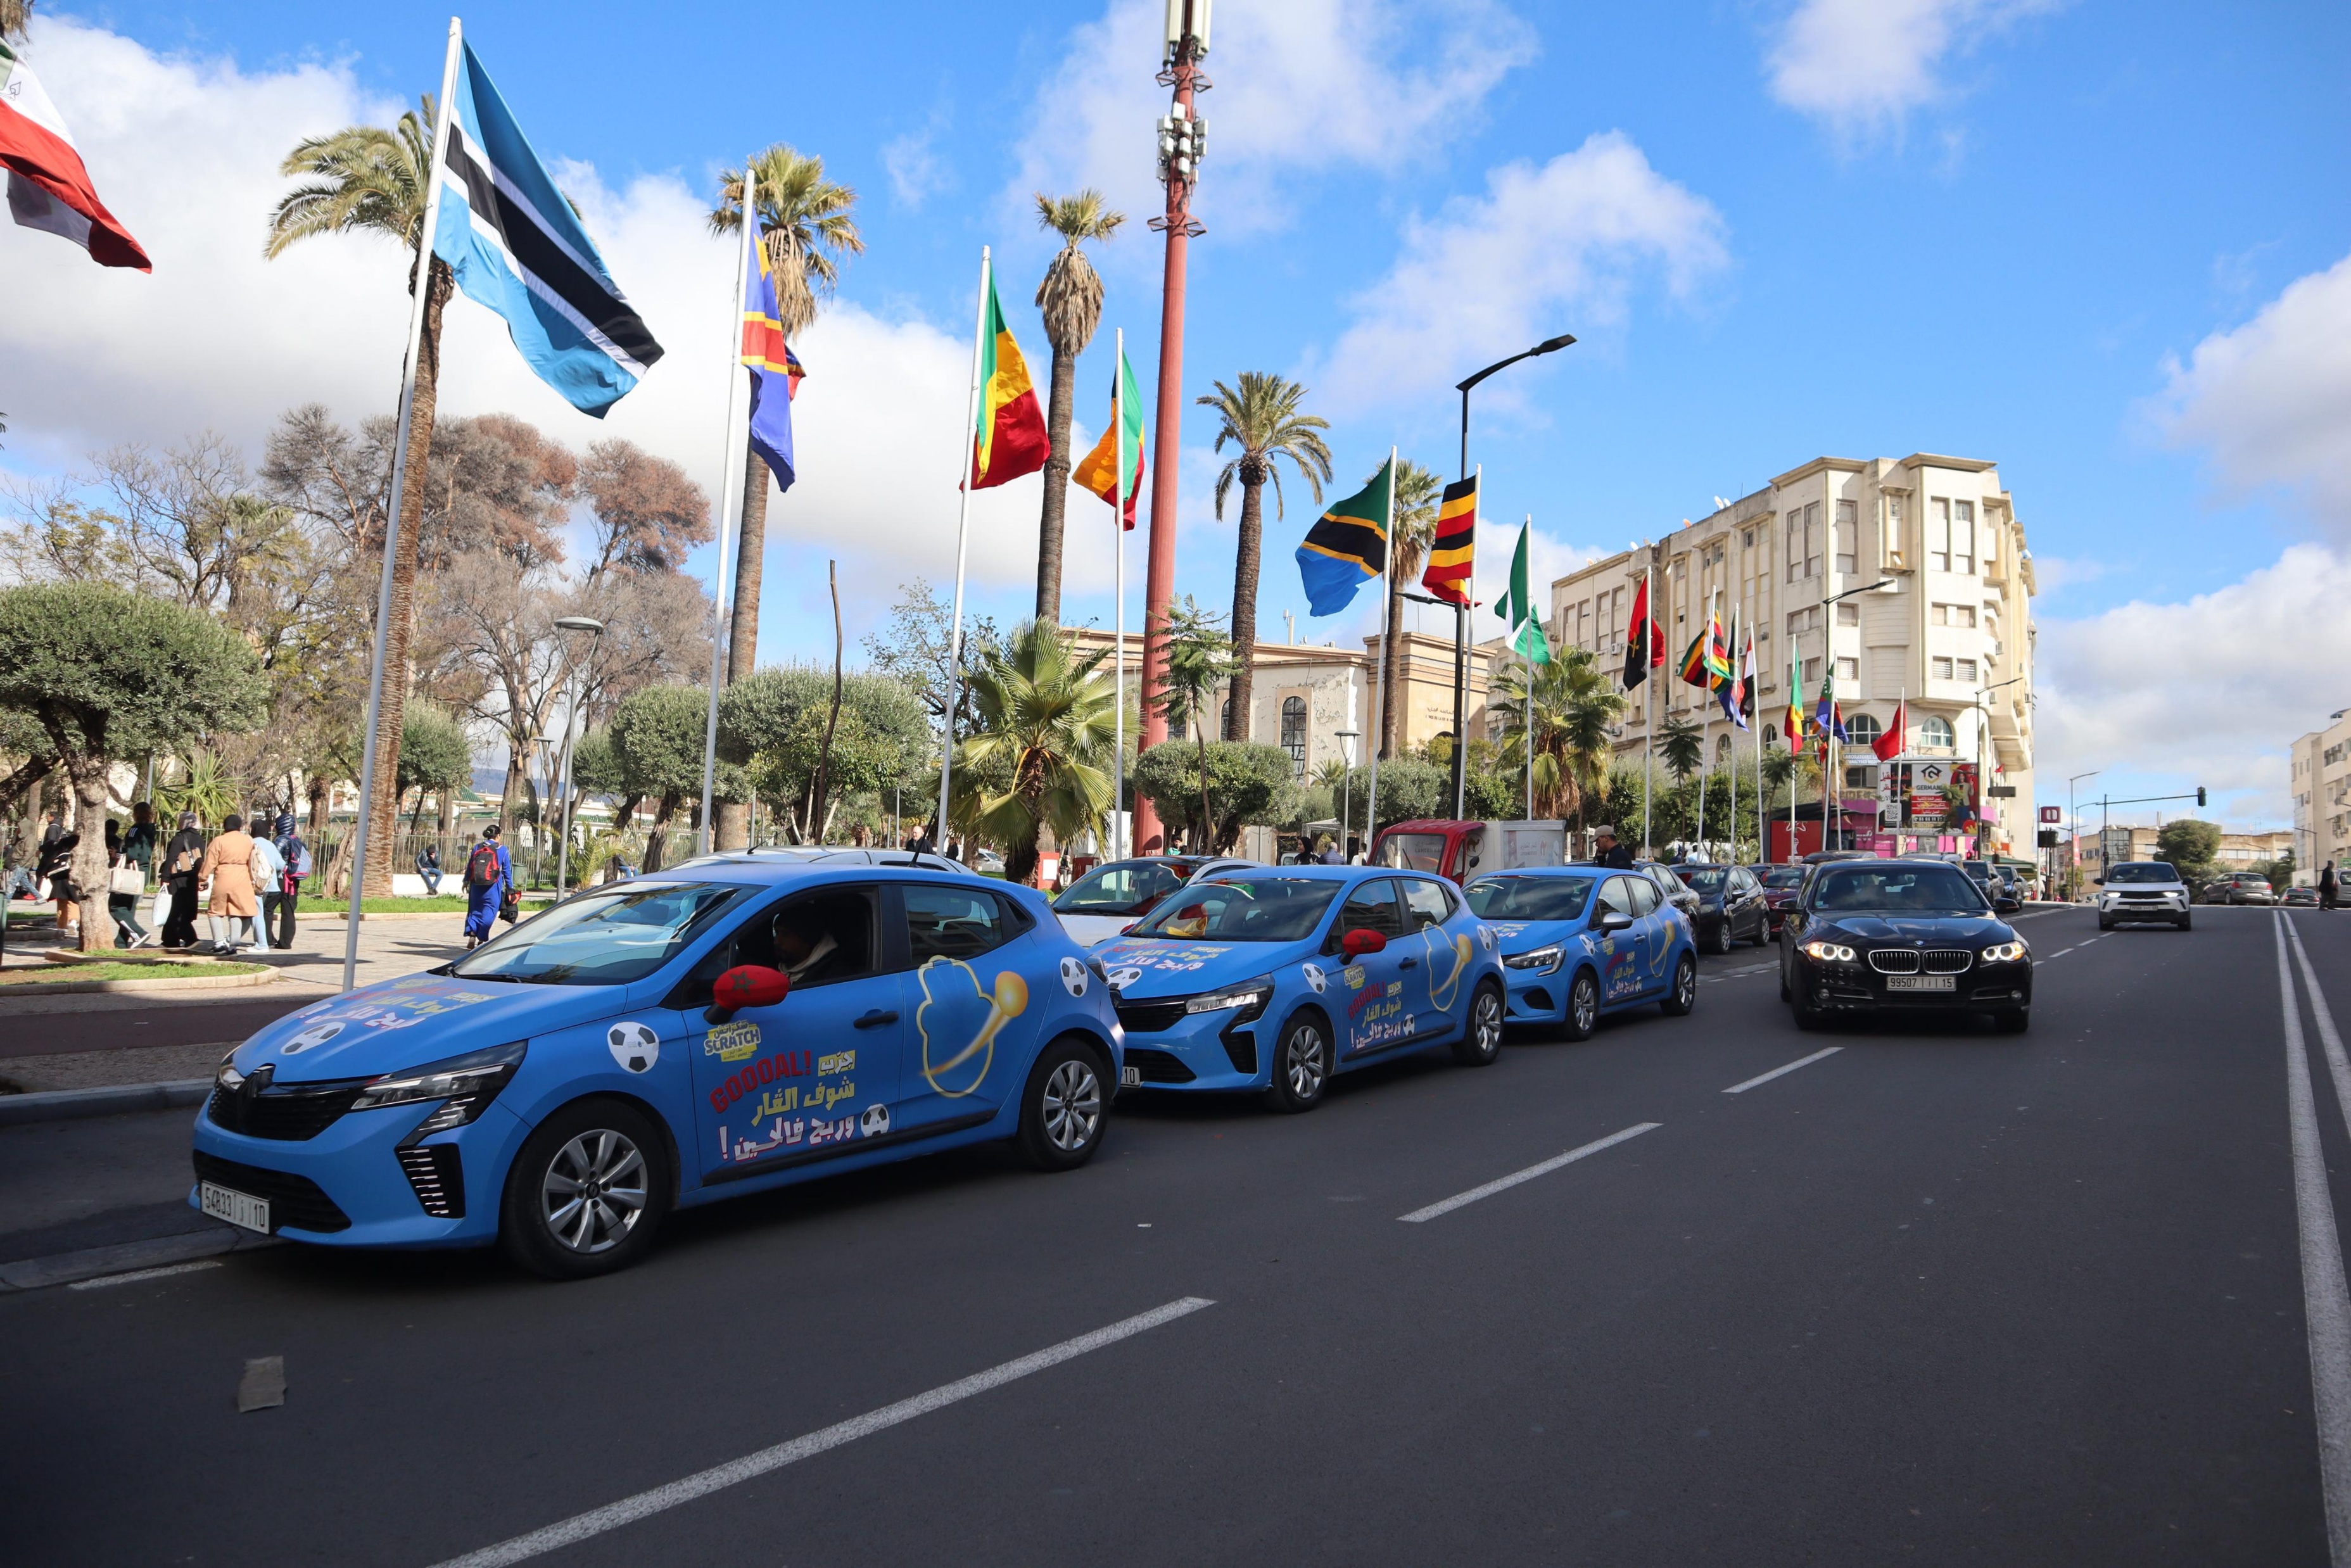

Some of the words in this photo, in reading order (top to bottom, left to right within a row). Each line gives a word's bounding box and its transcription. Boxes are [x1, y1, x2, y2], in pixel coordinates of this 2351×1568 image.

[1891, 978, 1917, 988] 99507
[1942, 978, 1953, 988] 15
[704, 1027, 761, 1056] SCRATCH
[709, 1049, 811, 1114] GOOOAL!
[1124, 1068, 1135, 1084] 10
[803, 1075, 854, 1111] شوف
[733, 1116, 805, 1161] فالحين
[809, 1115, 854, 1145] وربح
[206, 1187, 232, 1217] 54833
[254, 1203, 265, 1227] 10
